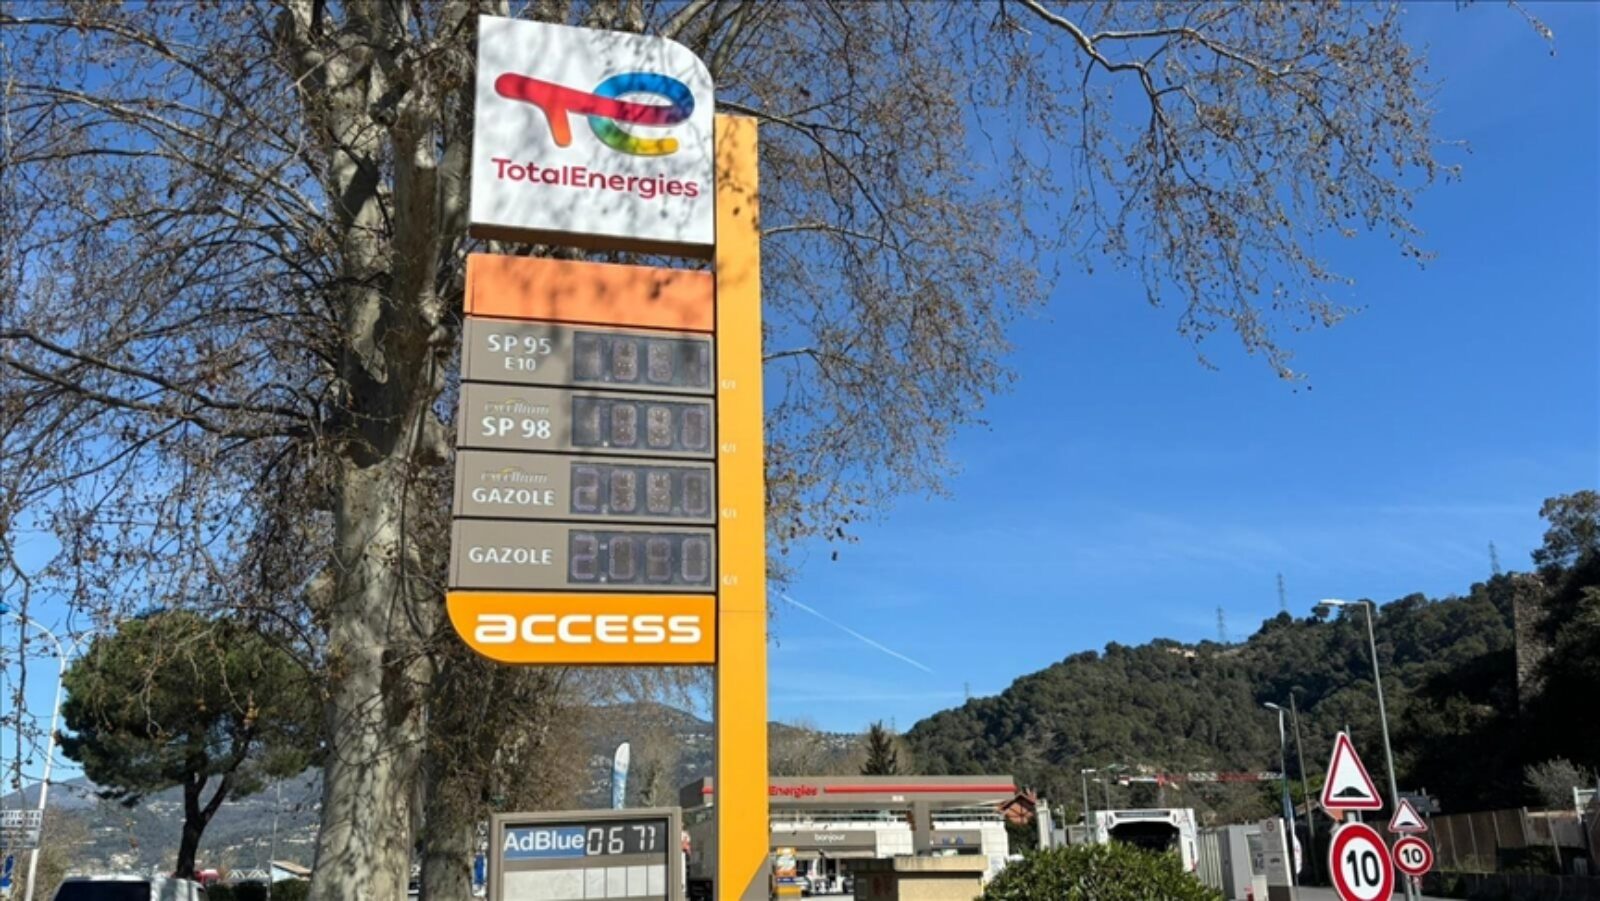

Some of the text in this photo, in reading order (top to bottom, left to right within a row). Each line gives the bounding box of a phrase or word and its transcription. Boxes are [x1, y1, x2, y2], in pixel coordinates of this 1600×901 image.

[491, 157, 699, 200] TotalEnergies
[487, 334, 552, 354] SP 95
[482, 415, 551, 440] SP 98
[472, 487, 555, 506] GAZOLE
[468, 546, 553, 565] GAZOLE
[504, 831, 584, 852] AdBlue
[1402, 848, 1423, 864] 10
[1346, 850, 1380, 887] 10
